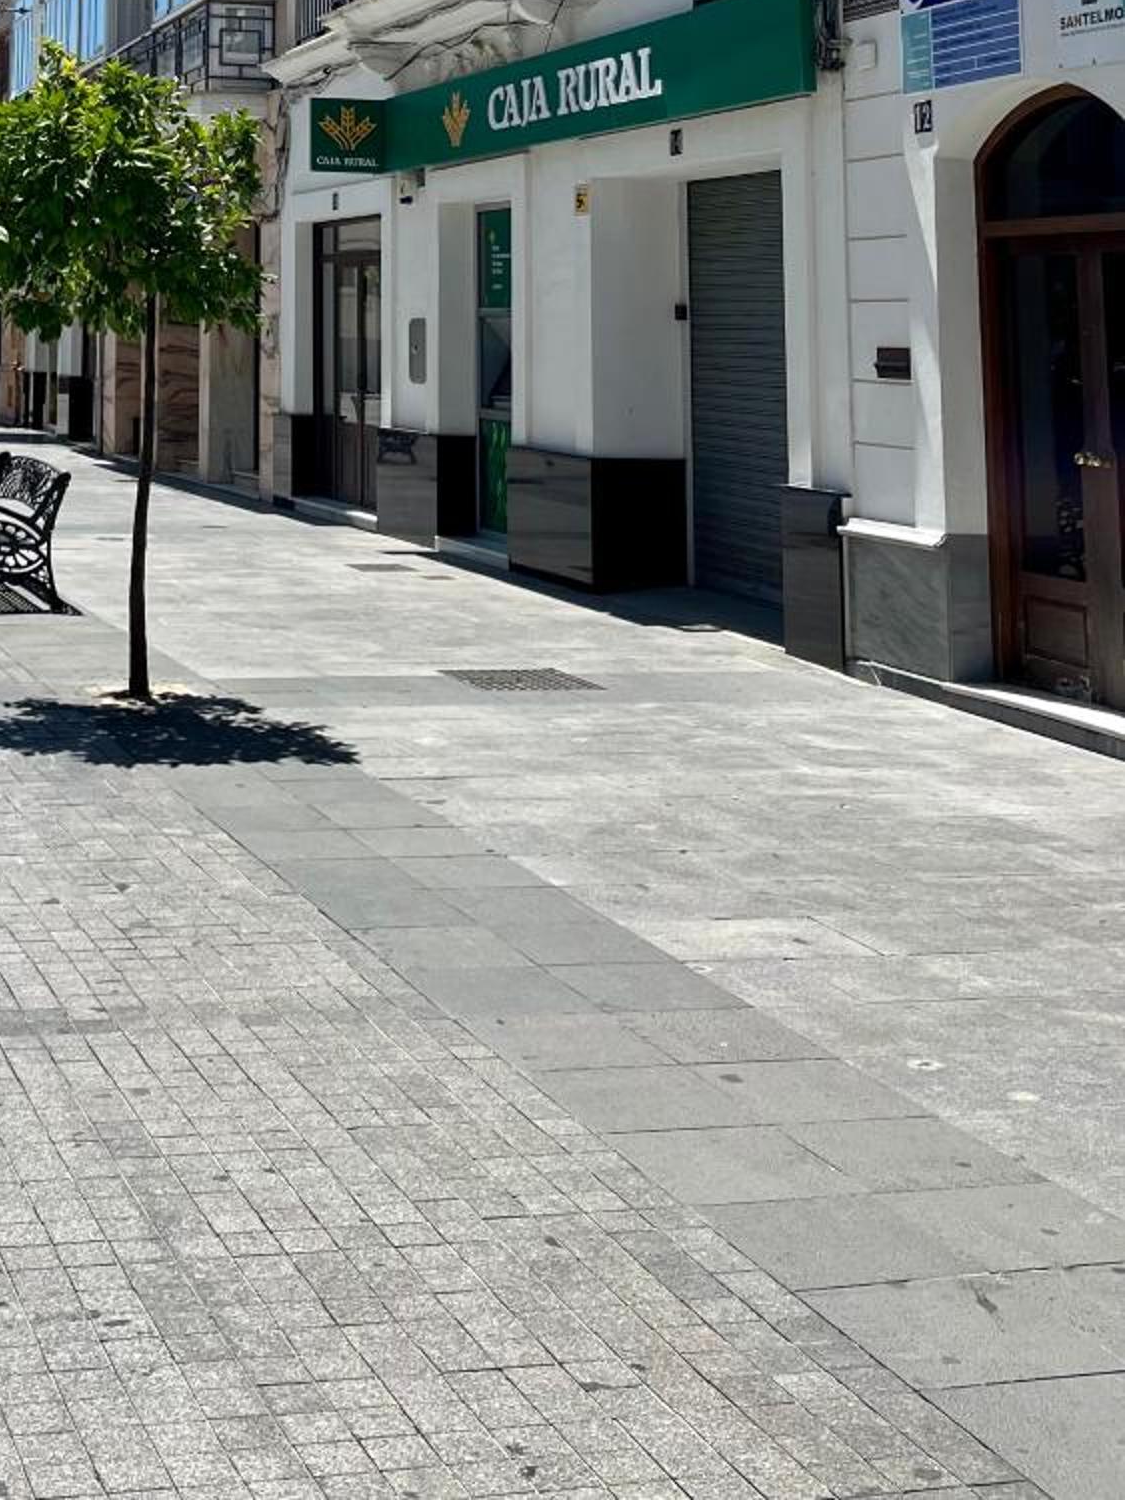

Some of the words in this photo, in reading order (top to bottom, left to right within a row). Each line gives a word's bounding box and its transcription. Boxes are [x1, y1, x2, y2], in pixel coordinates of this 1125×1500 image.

[1060, 6, 1124, 31] SANTELMO
[487, 75, 551, 131] CAJA
[557, 47, 663, 116] RURAL
[916, 103, 932, 131] 12
